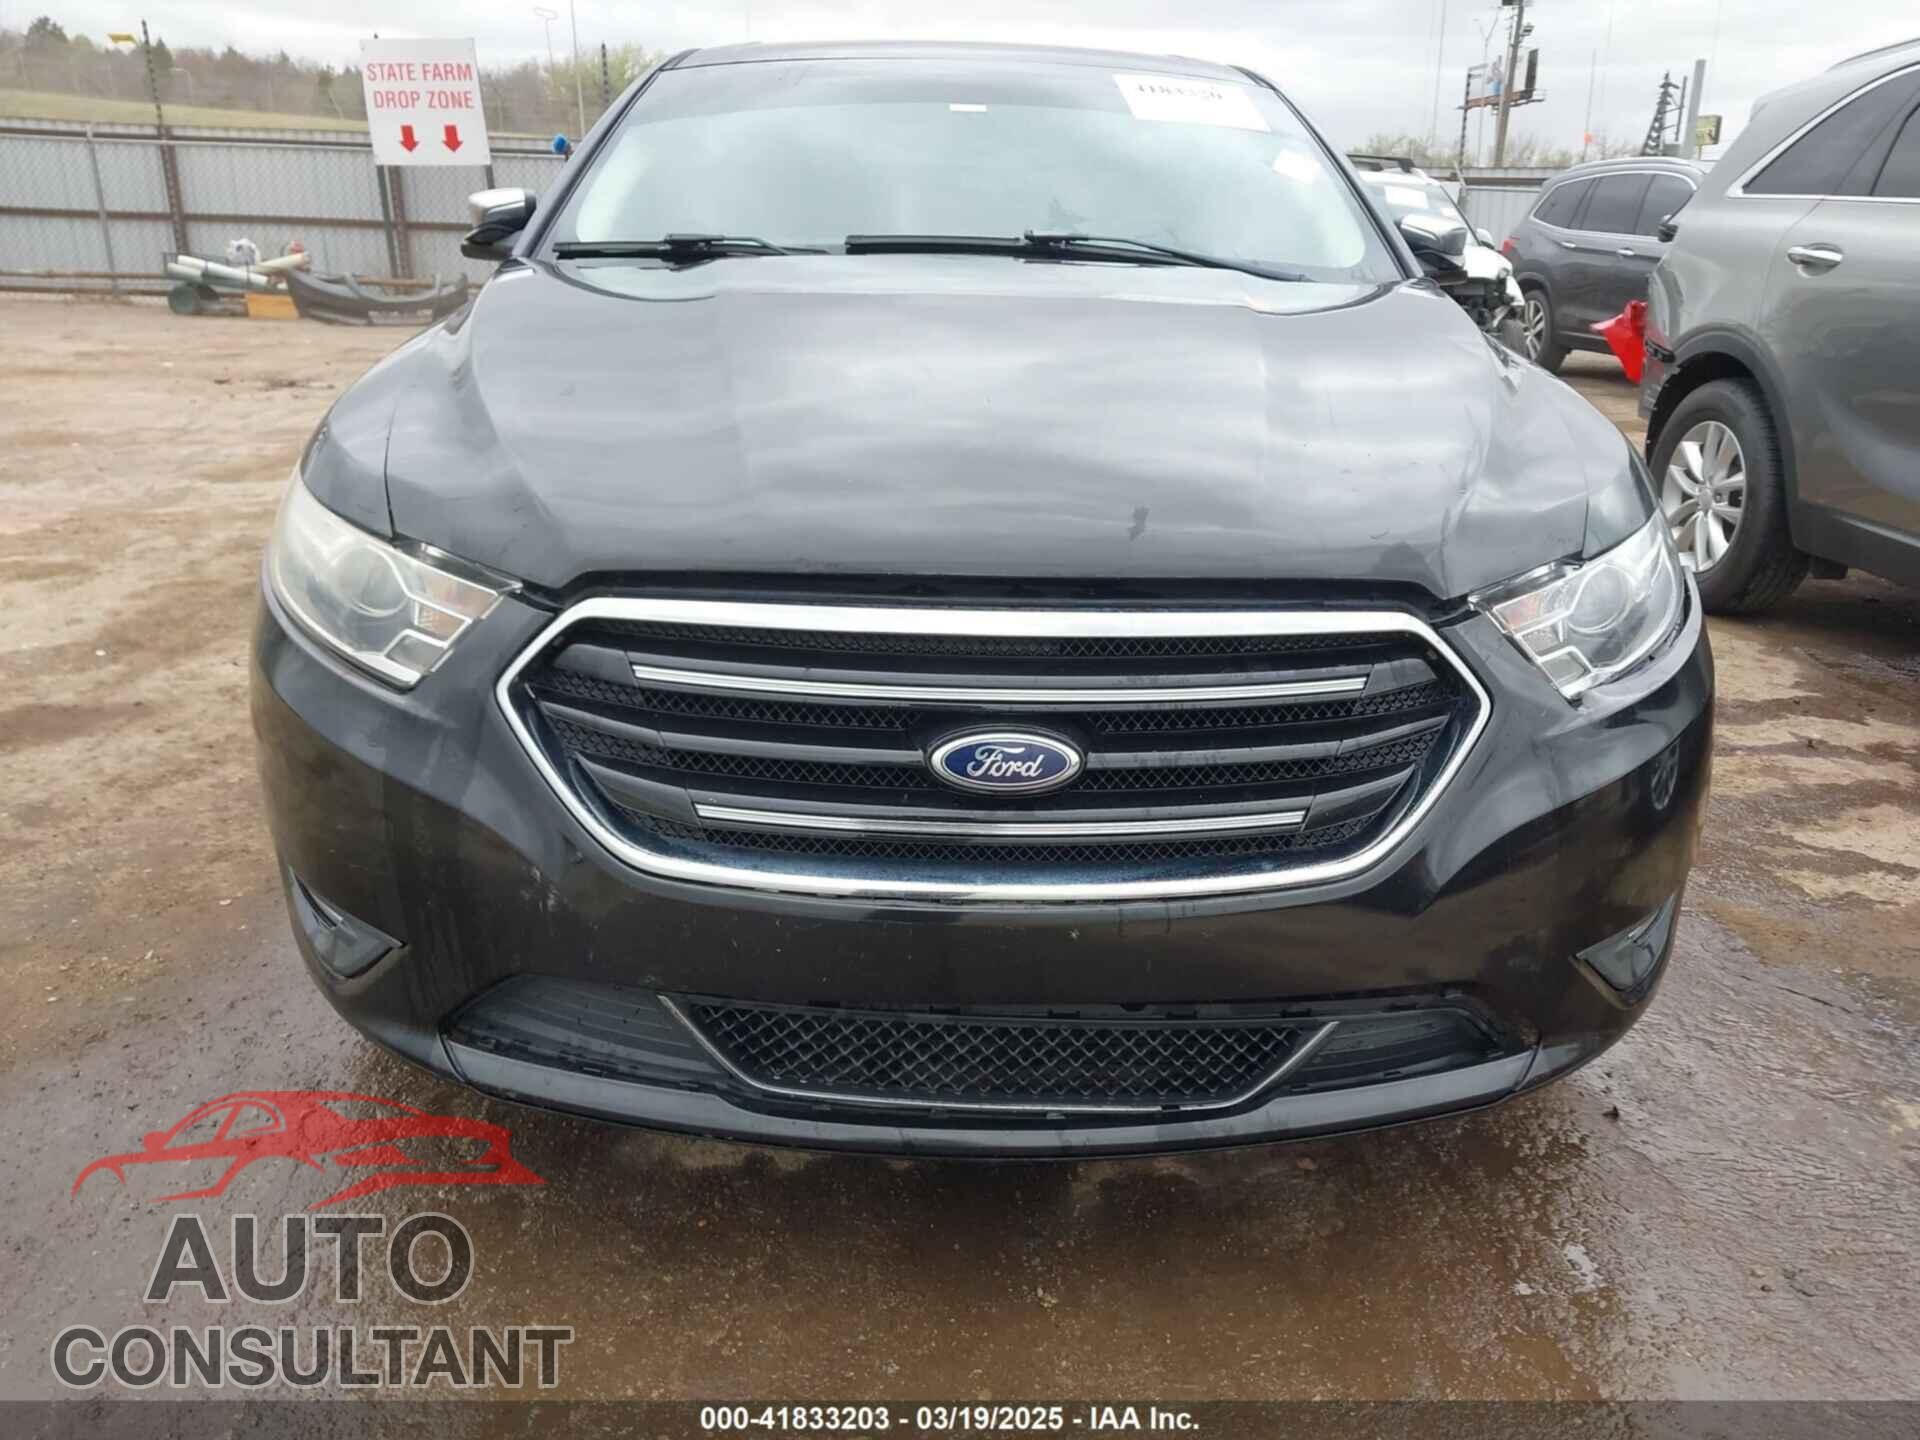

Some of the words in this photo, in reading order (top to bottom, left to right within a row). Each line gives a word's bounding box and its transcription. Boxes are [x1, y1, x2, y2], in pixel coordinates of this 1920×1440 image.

[367, 63, 416, 82] STATE
[422, 63, 473, 82] FARM
[373, 90, 421, 109] DROP
[426, 90, 475, 109] ZONE
[966, 744, 1046, 777] Ford
